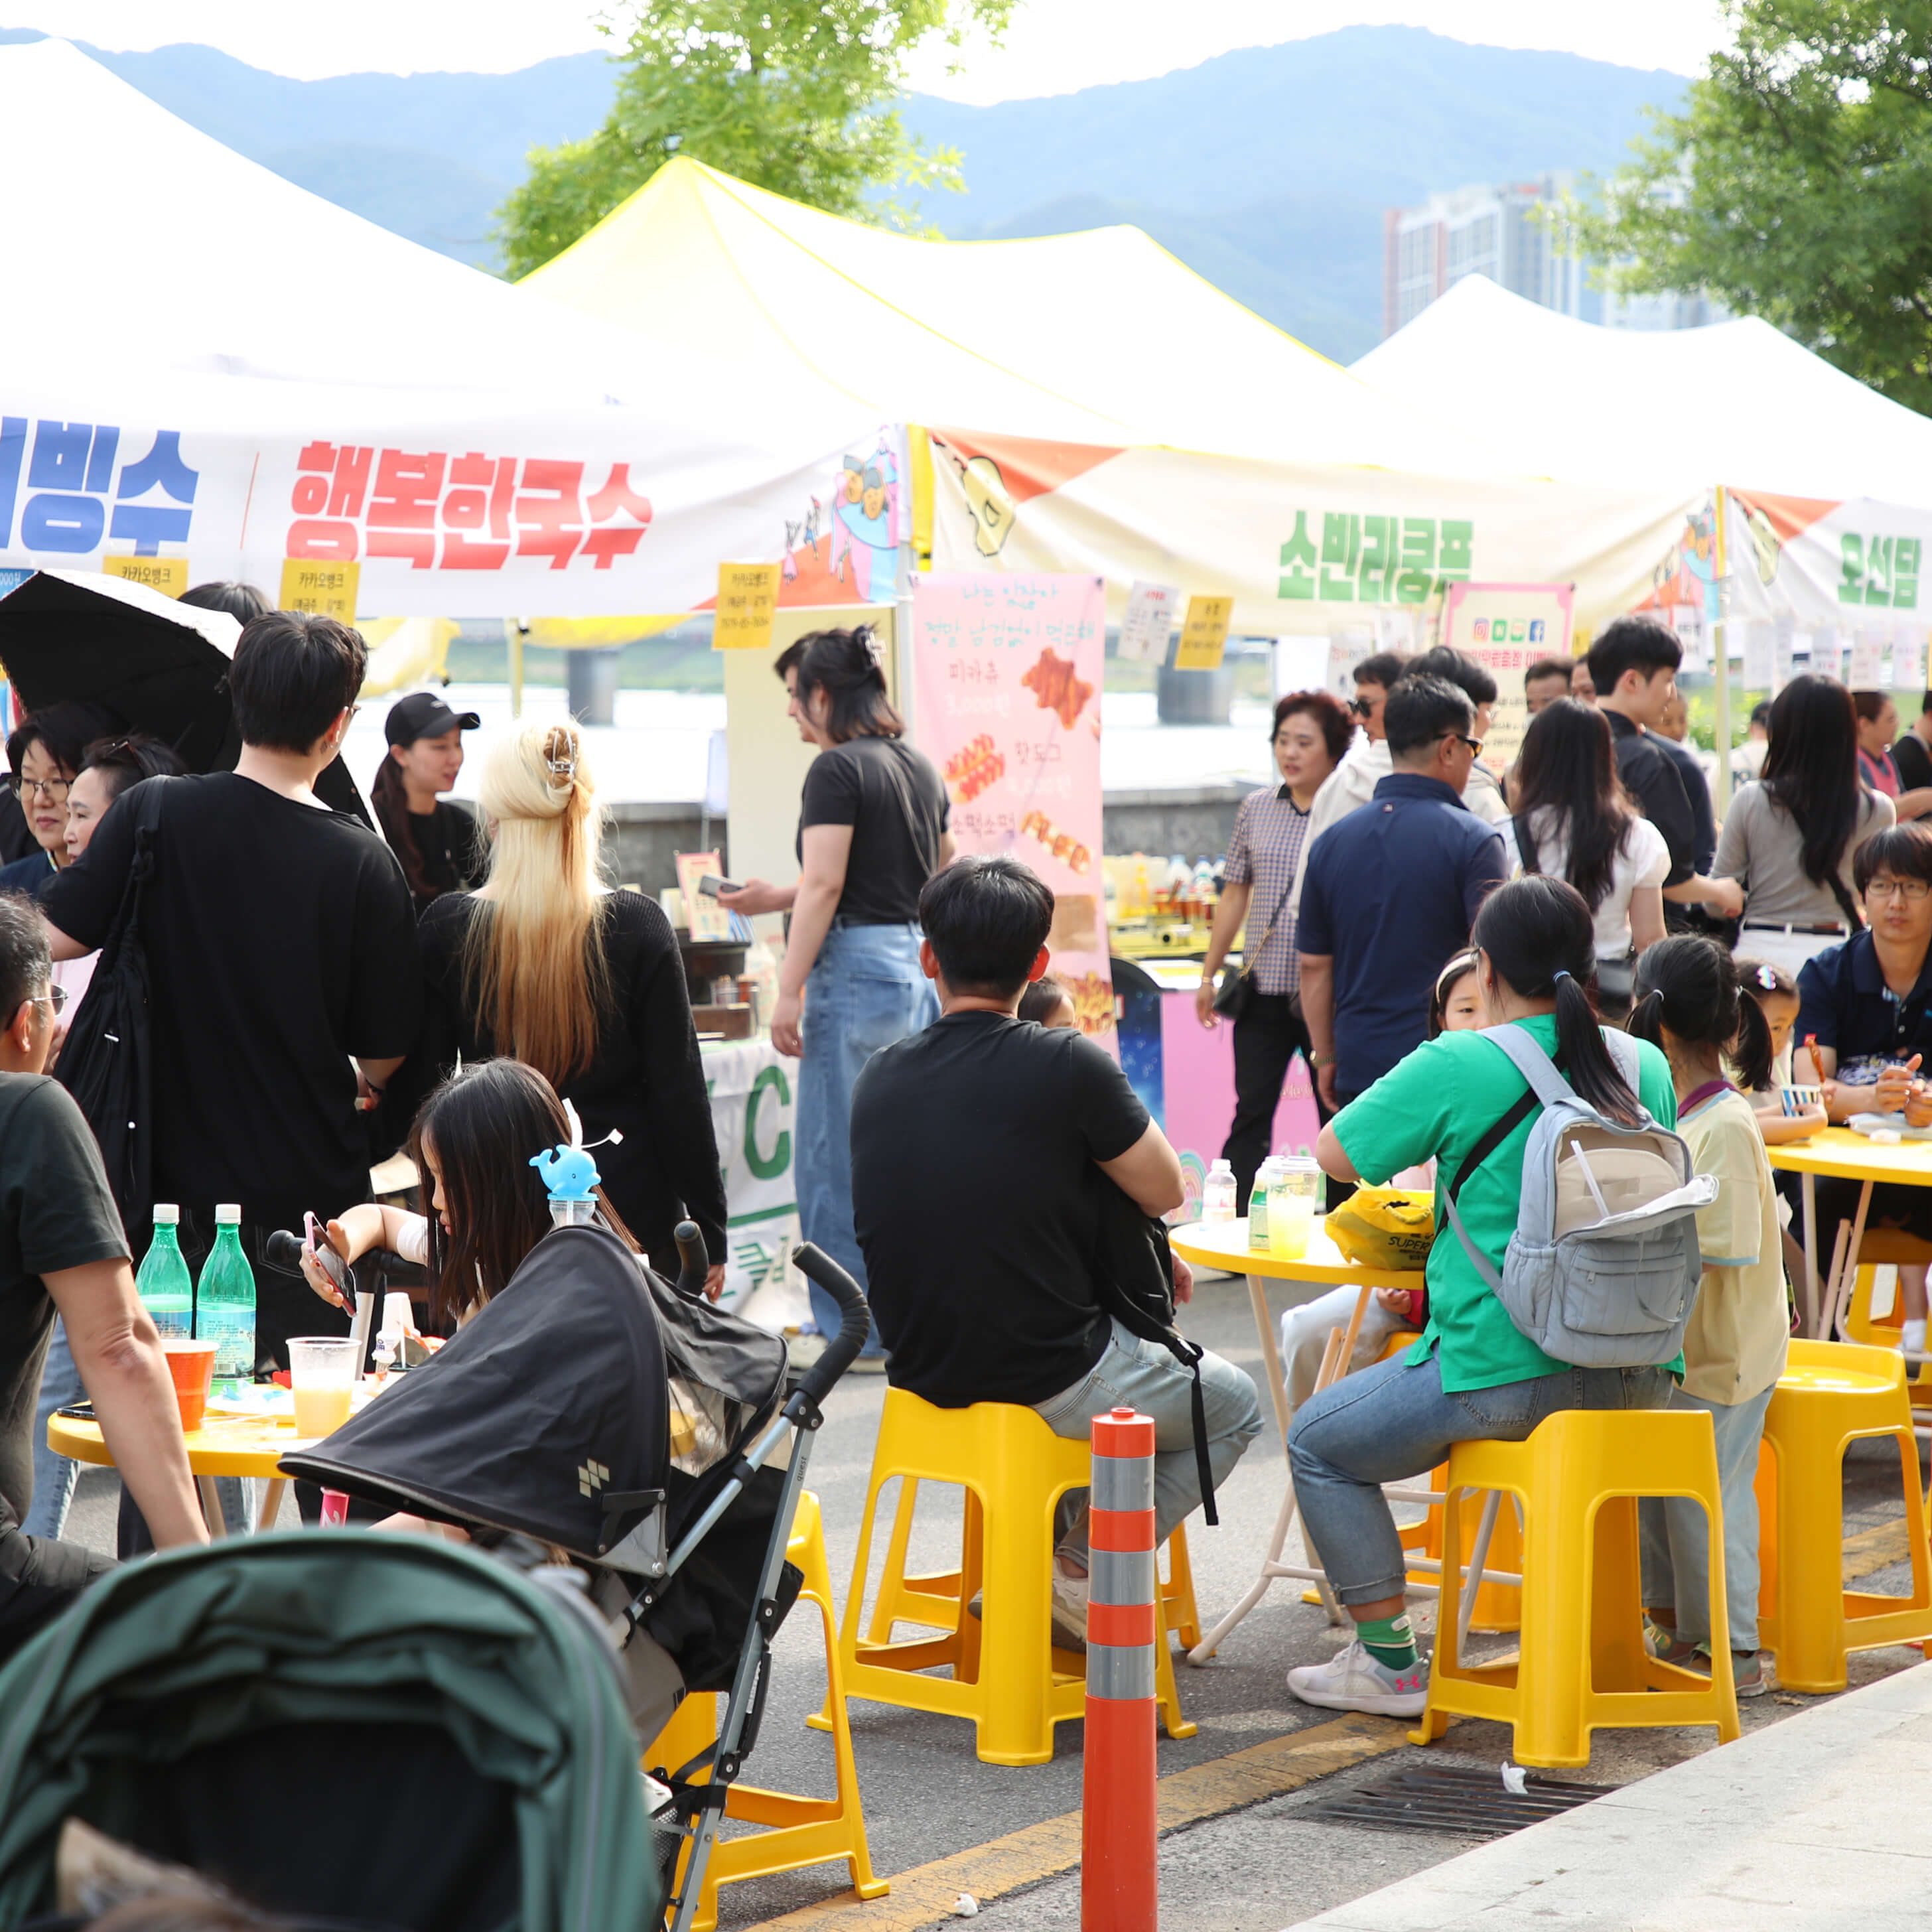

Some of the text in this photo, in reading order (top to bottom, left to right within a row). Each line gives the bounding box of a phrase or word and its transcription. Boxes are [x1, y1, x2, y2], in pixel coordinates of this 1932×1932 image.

[287, 441, 652, 571] 행복한국수
[299, 572, 344, 589] 카카오뱅크
[1388, 1237, 1431, 1251] SUPER
[796, 1456, 807, 1482] quest
